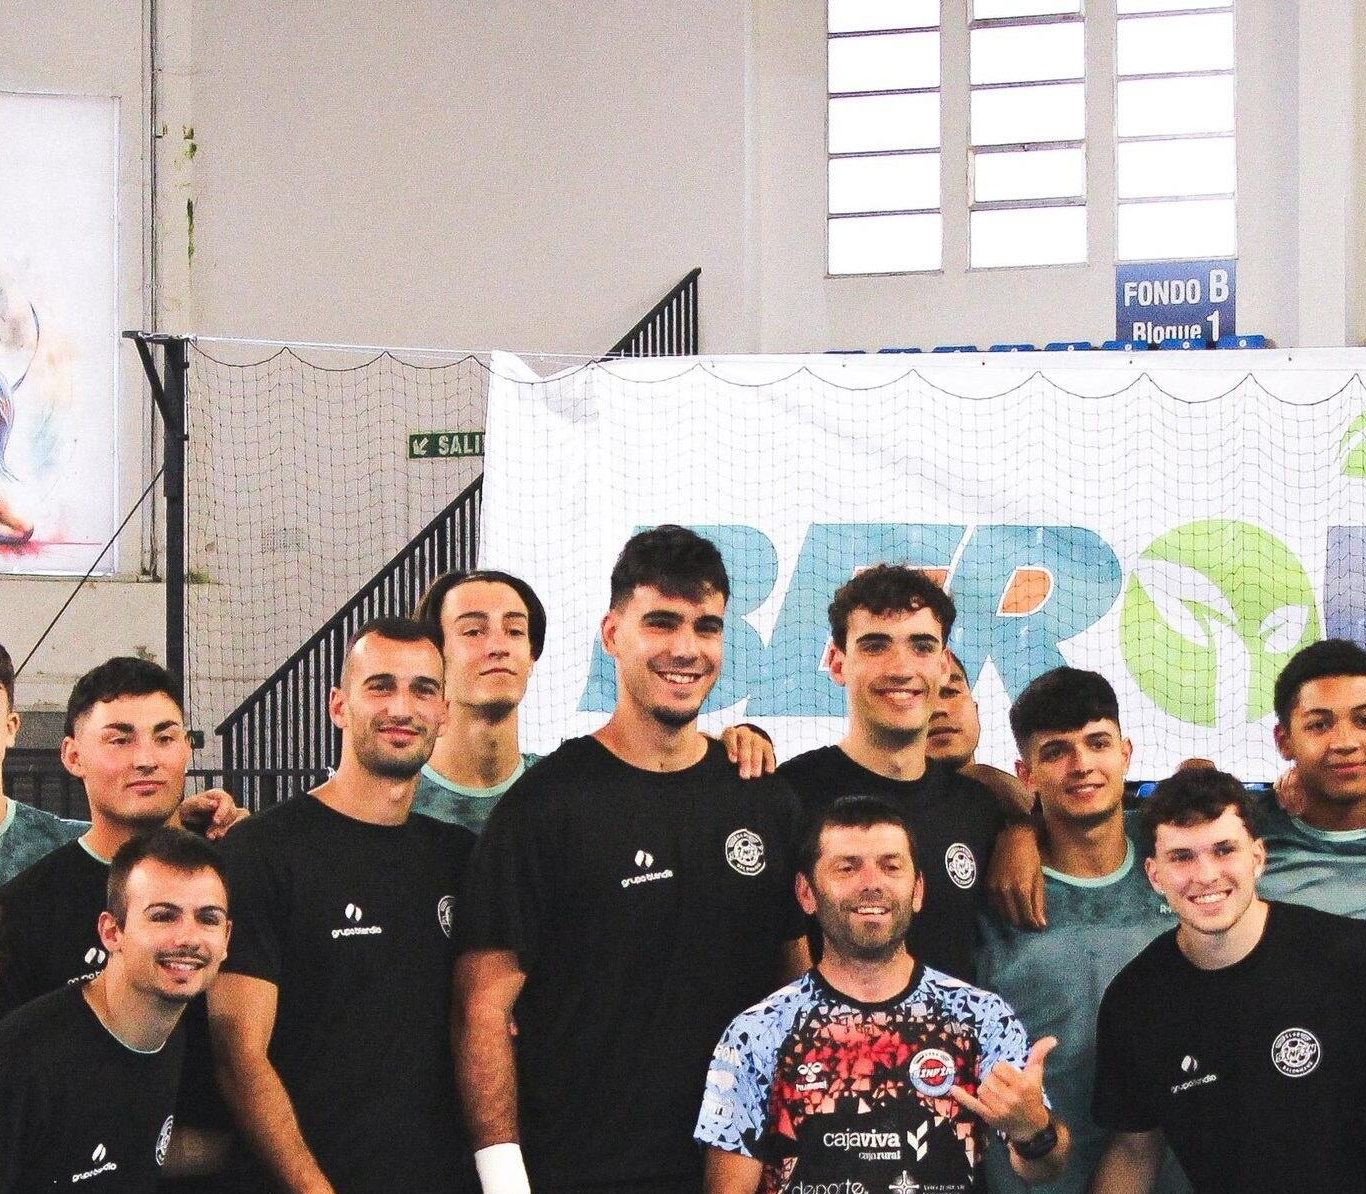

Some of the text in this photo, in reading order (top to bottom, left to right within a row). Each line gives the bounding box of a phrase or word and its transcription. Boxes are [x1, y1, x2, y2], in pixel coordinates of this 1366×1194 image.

[1123, 268, 1229, 307] FONDO B
[1132, 310, 1220, 344] Bloque 1
[823, 1128, 902, 1151] cajaviva
